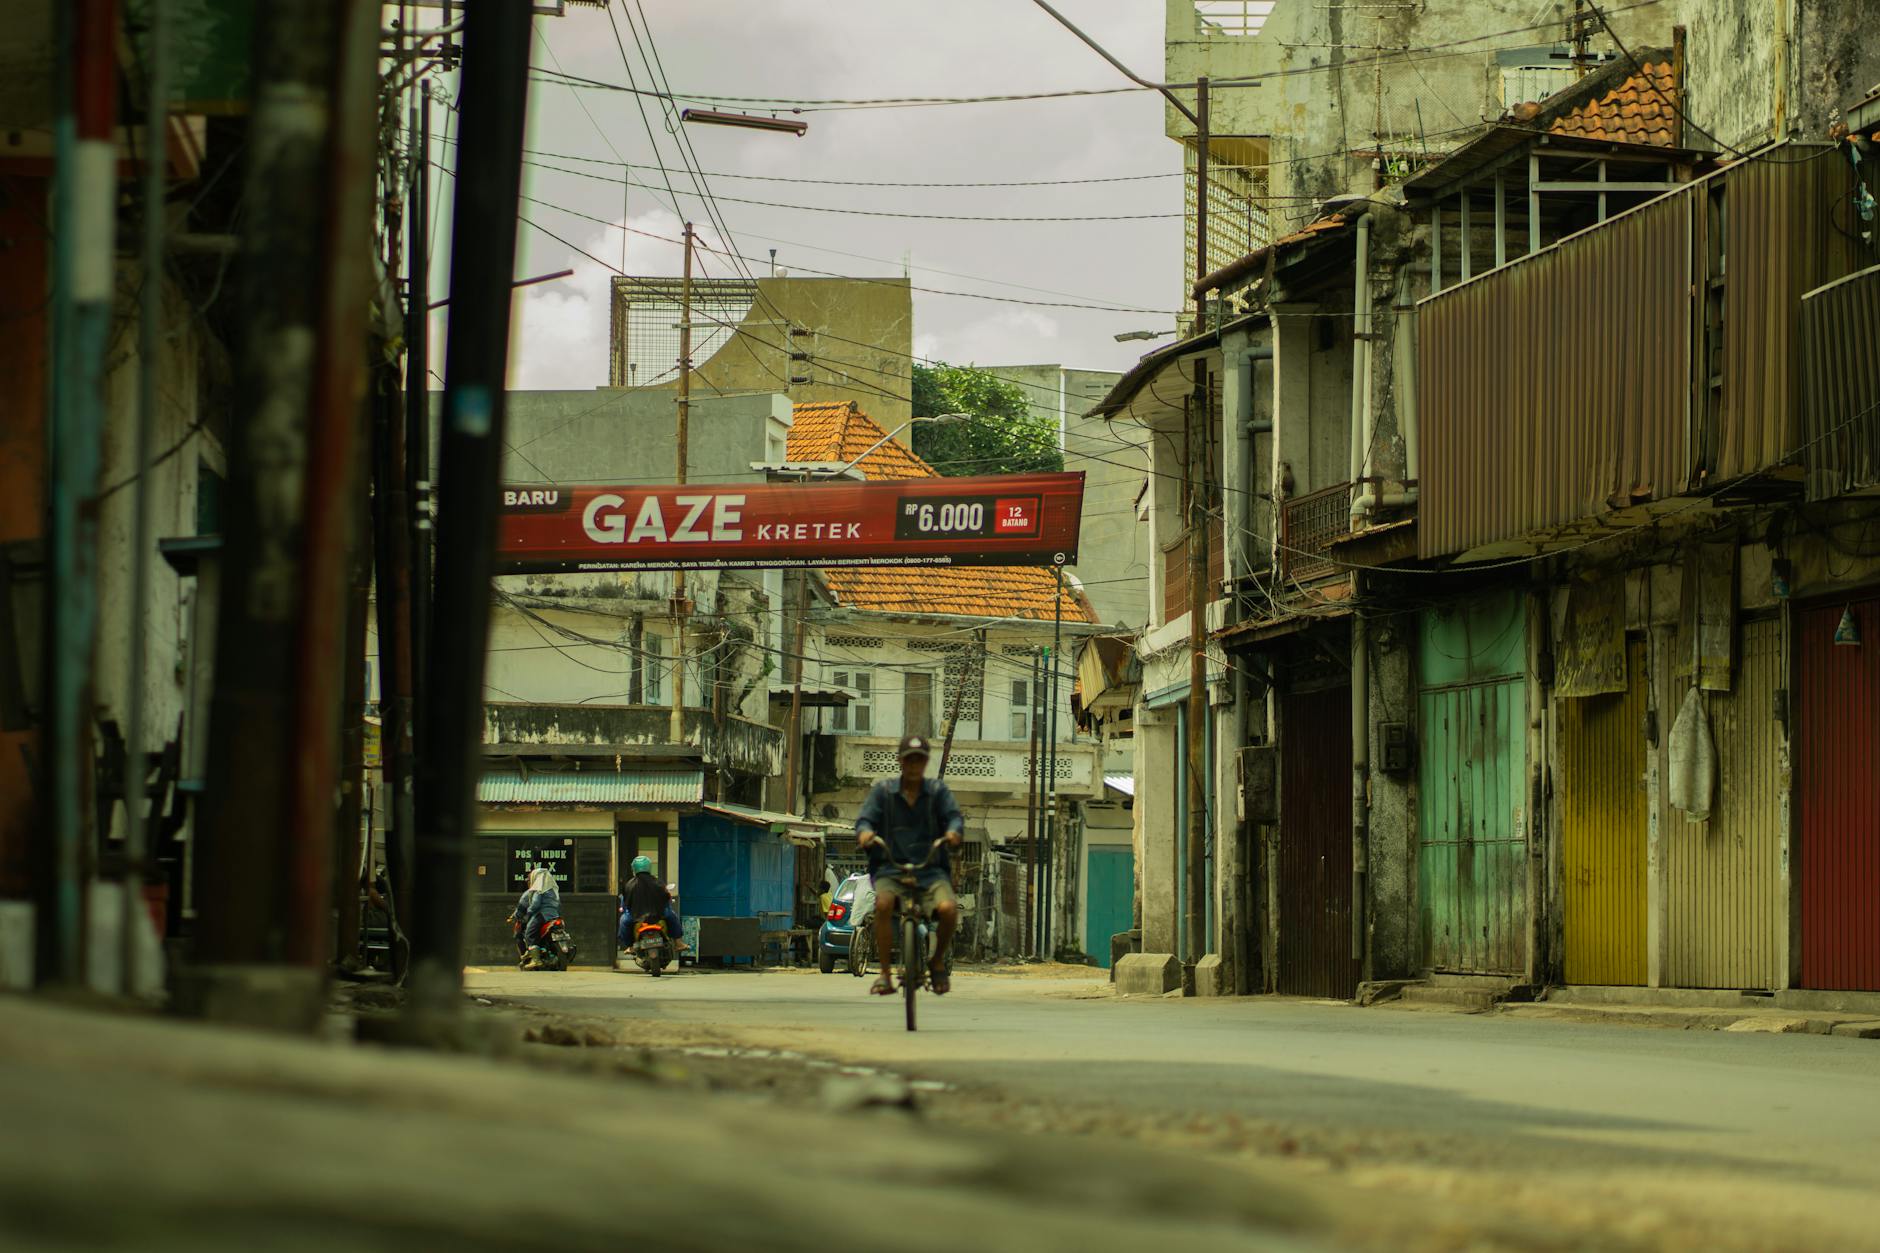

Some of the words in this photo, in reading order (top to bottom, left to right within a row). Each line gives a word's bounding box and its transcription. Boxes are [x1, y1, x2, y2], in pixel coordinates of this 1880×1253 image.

[504, 490, 558, 506] BARU
[905, 503, 918, 516] RP
[918, 503, 984, 532] 6.000
[1008, 506, 1022, 518] 12
[582, 494, 746, 543] GAZE
[757, 522, 862, 540] KRETEK
[1002, 518, 1028, 527] BATANG
[698, 560, 728, 568] TERKENA
[837, 558, 870, 566] BERHENTI
[515, 850, 532, 859] POS
[541, 850, 567, 859] INDUK
[548, 861, 556, 872] X
